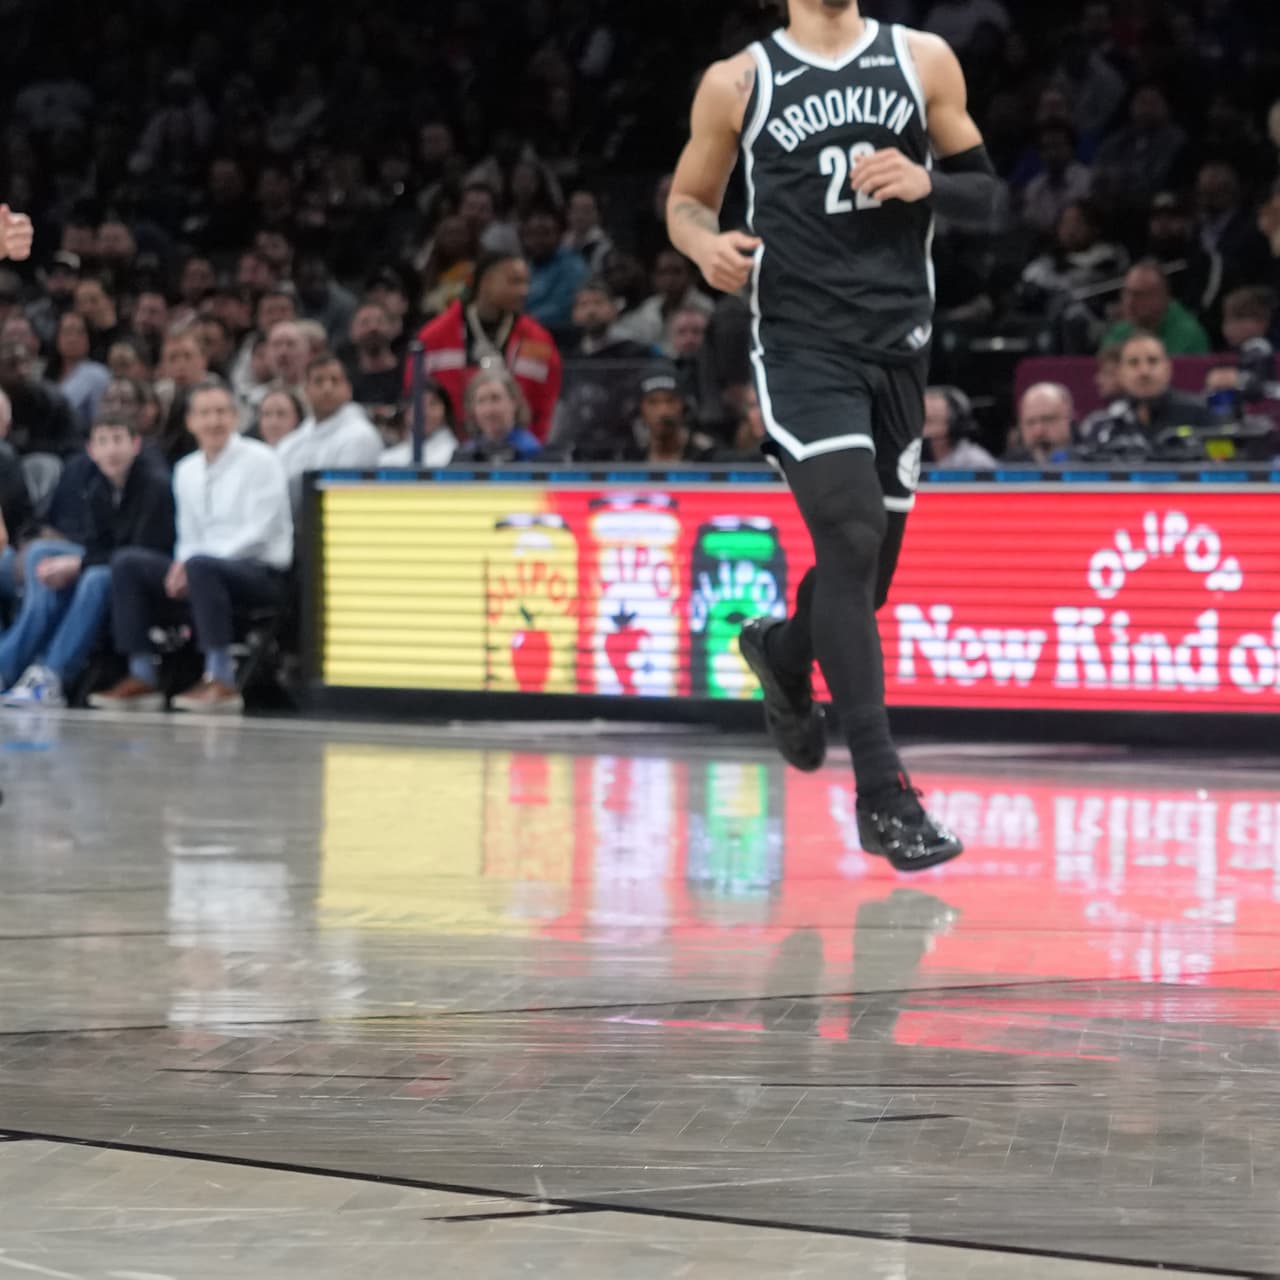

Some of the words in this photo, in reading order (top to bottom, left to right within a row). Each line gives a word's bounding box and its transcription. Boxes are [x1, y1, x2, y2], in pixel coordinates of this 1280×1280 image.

[767, 86, 915, 152] BROOKLYN
[1088, 511, 1243, 598] OLIPOP
[895, 604, 1047, 685] New
[1053, 606, 1220, 692] Kind
